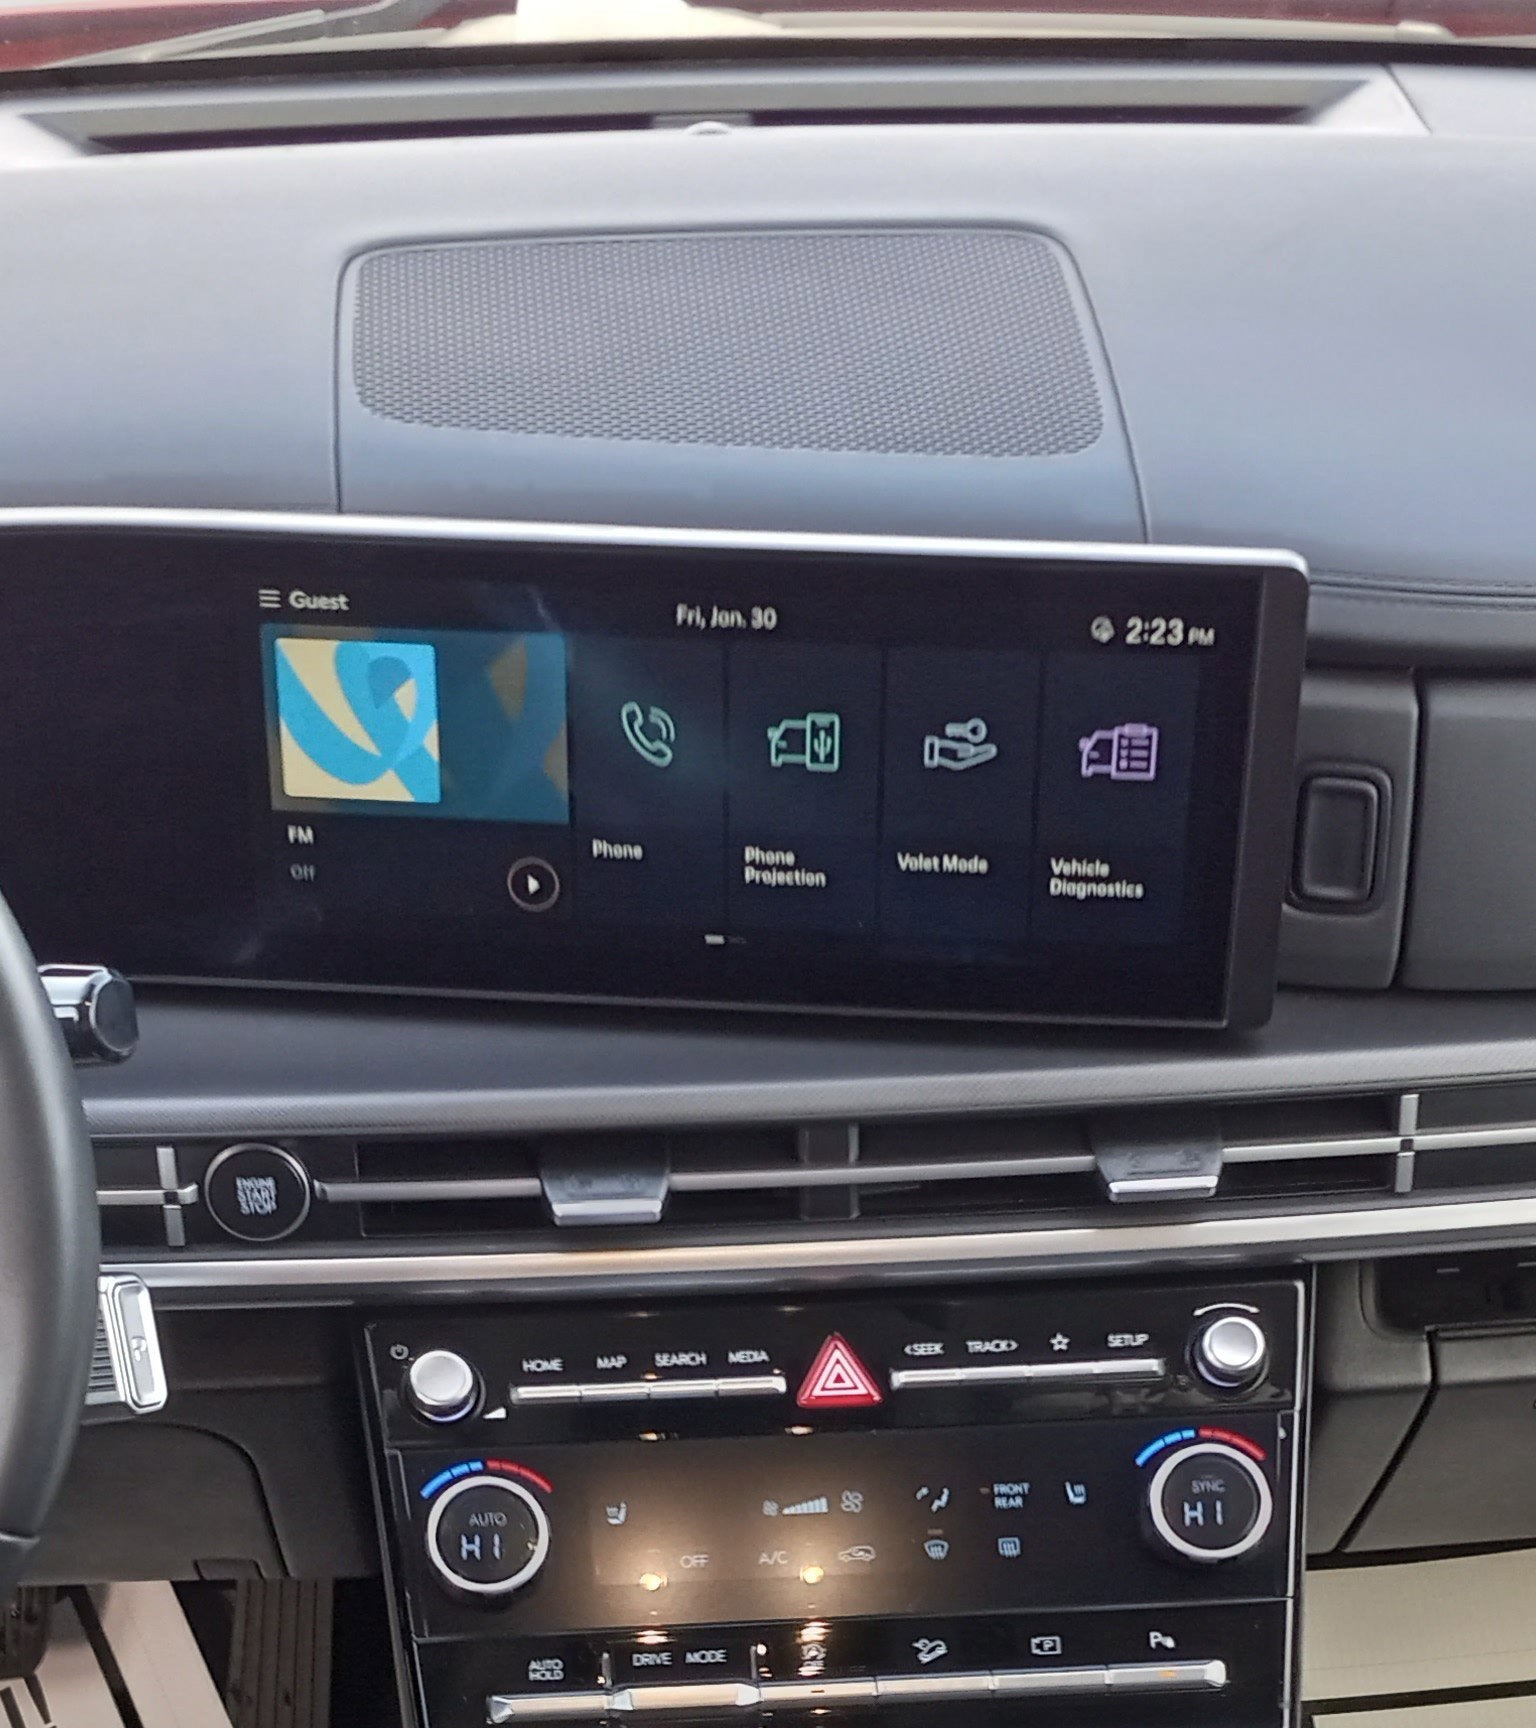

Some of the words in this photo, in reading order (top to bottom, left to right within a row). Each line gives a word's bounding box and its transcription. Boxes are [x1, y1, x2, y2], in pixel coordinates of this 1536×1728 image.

[288, 590, 349, 611] Guest
[676, 603, 705, 629] Fri,
[710, 606, 747, 630] Jan.
[751, 607, 778, 630] 30
[1125, 616, 1184, 646] 2:23
[1187, 626, 1215, 646] PM
[287, 825, 314, 844] FM
[592, 838, 644, 861] Phone
[744, 845, 796, 866] Phone
[897, 852, 940, 872] Valet
[943, 854, 989, 875] Mode
[1050, 858, 1110, 878] Vehicle
[744, 867, 827, 888] Projection
[1049, 878, 1145, 900] Diagnostics
[235, 1176, 276, 1190] ENGINE
[237, 1188, 277, 1203] START
[240, 1199, 278, 1216] STOP
[522, 1358, 564, 1372] HOME
[596, 1355, 627, 1369] MAP
[654, 1351, 707, 1367] SEARCH
[727, 1349, 770, 1364] MEDIA
[1107, 1333, 1150, 1348] SETUP
[993, 1483, 1031, 1495] FRONT
[1191, 1479, 1226, 1494] SYNC
[994, 1496, 1025, 1509] REAR
[468, 1511, 508, 1528] AUTO
[679, 1554, 710, 1570] OFF
[758, 1550, 788, 1566] A/C
[528, 1658, 564, 1671] AUTO
[632, 1652, 672, 1667] DRIVE
[684, 1649, 727, 1664] MODE
[528, 1670, 564, 1682] HOLD
